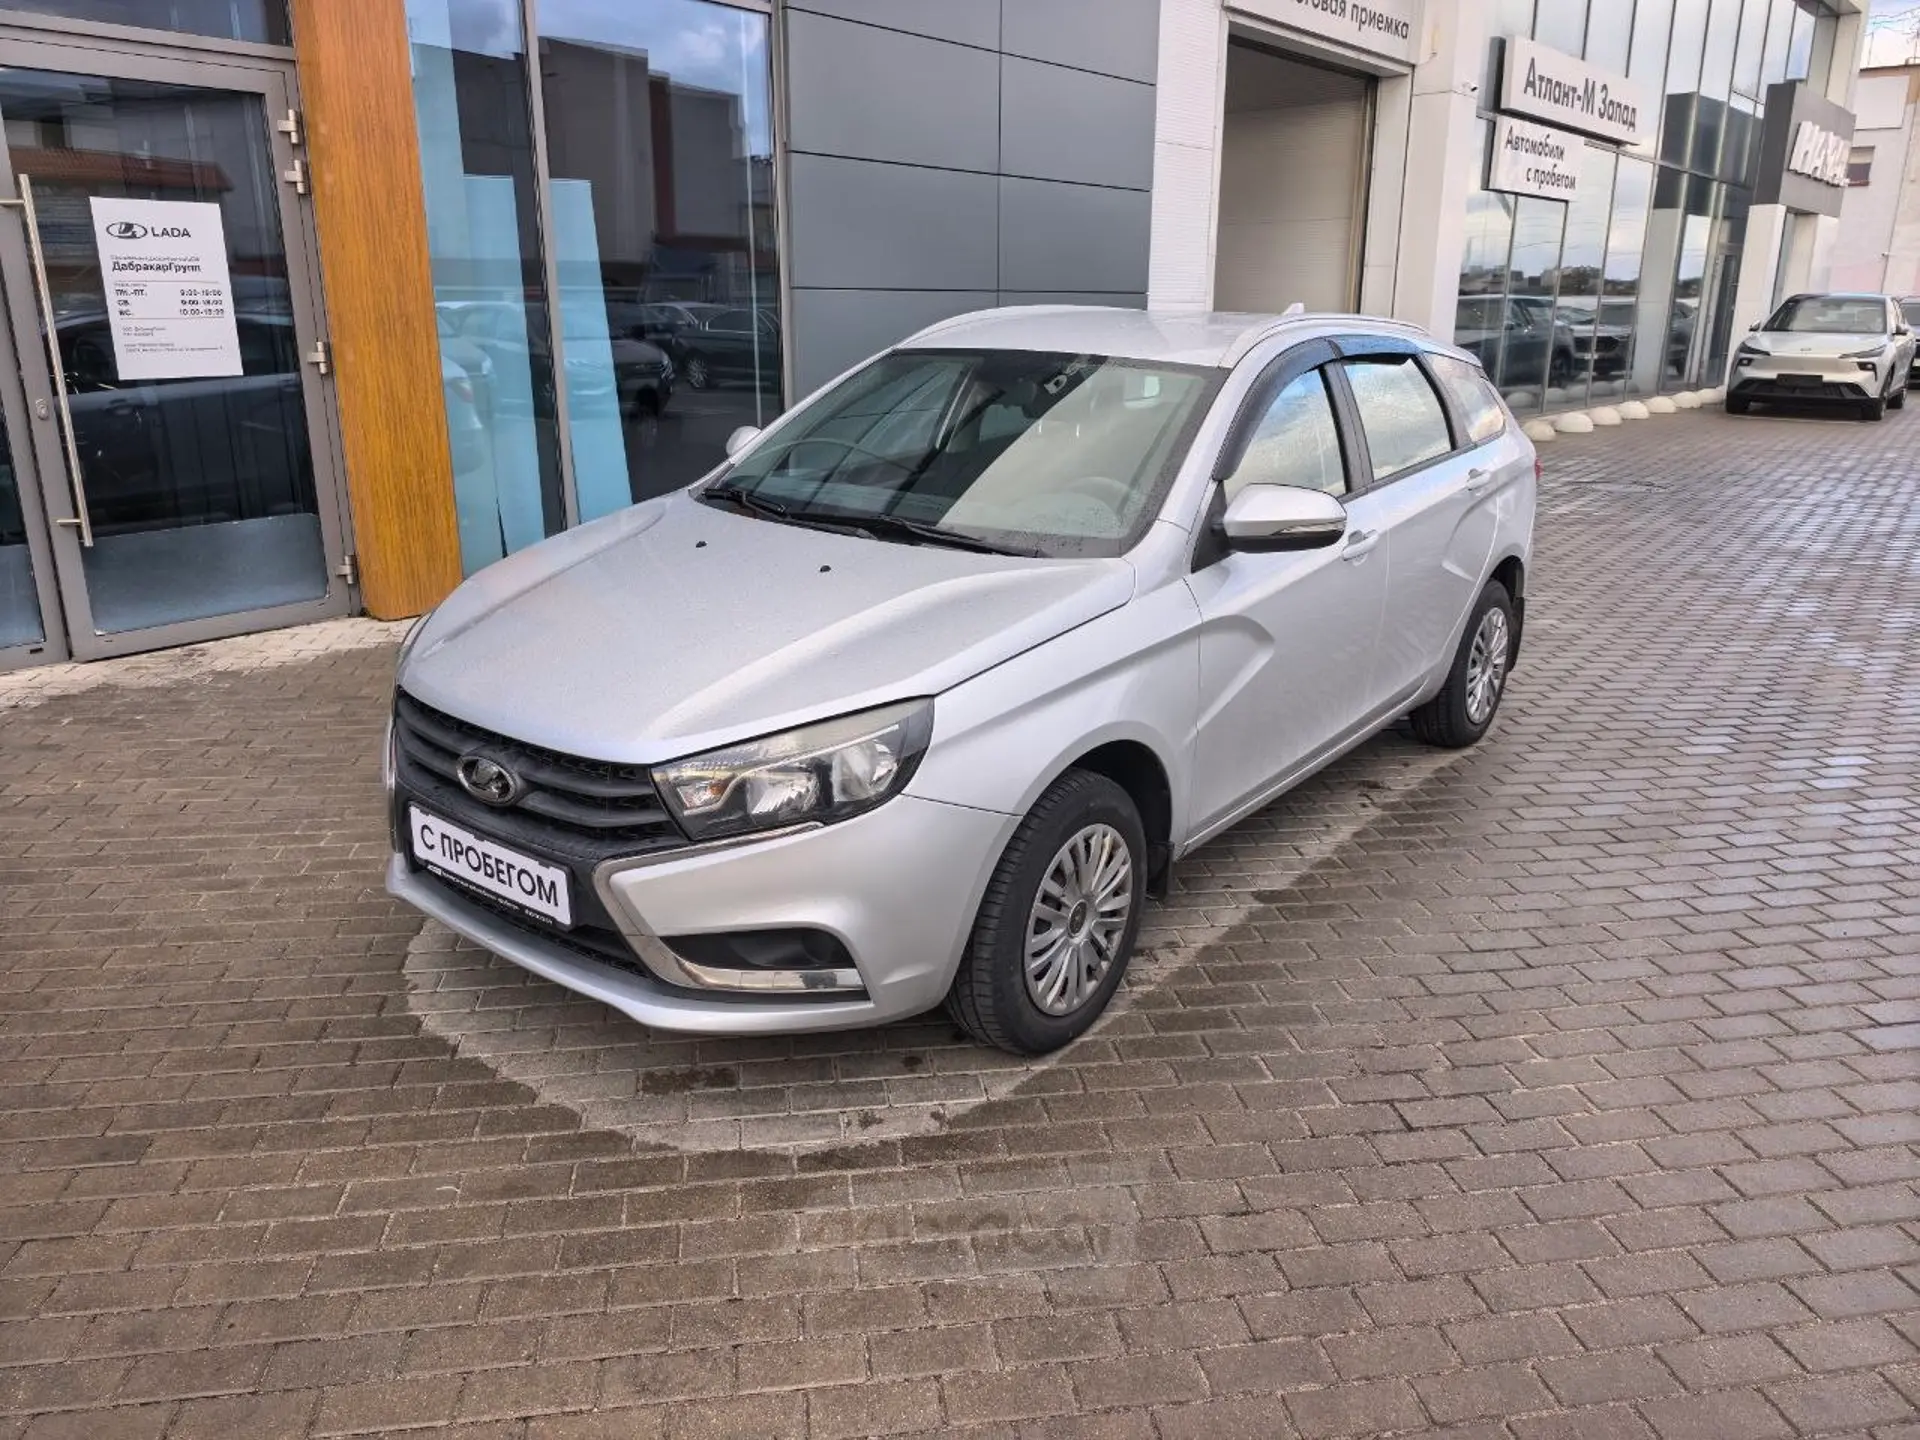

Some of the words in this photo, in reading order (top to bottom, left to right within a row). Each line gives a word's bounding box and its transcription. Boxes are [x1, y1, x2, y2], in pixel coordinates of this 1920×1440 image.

[1296, 0, 1346, 18] овая
[1351, 3, 1409, 39] приемка
[1523, 56, 1596, 115] Атлант-М
[1598, 83, 1637, 132] Запад
[1505, 125, 1566, 162] Автомобили
[1525, 167, 1533, 182] с
[1533, 163, 1576, 190] пробегом
[151, 226, 192, 238] LADA
[111, 260, 201, 274] ДабракарГрупп
[420, 824, 435, 851] С
[440, 832, 559, 907] ПРОБЕГОМ
